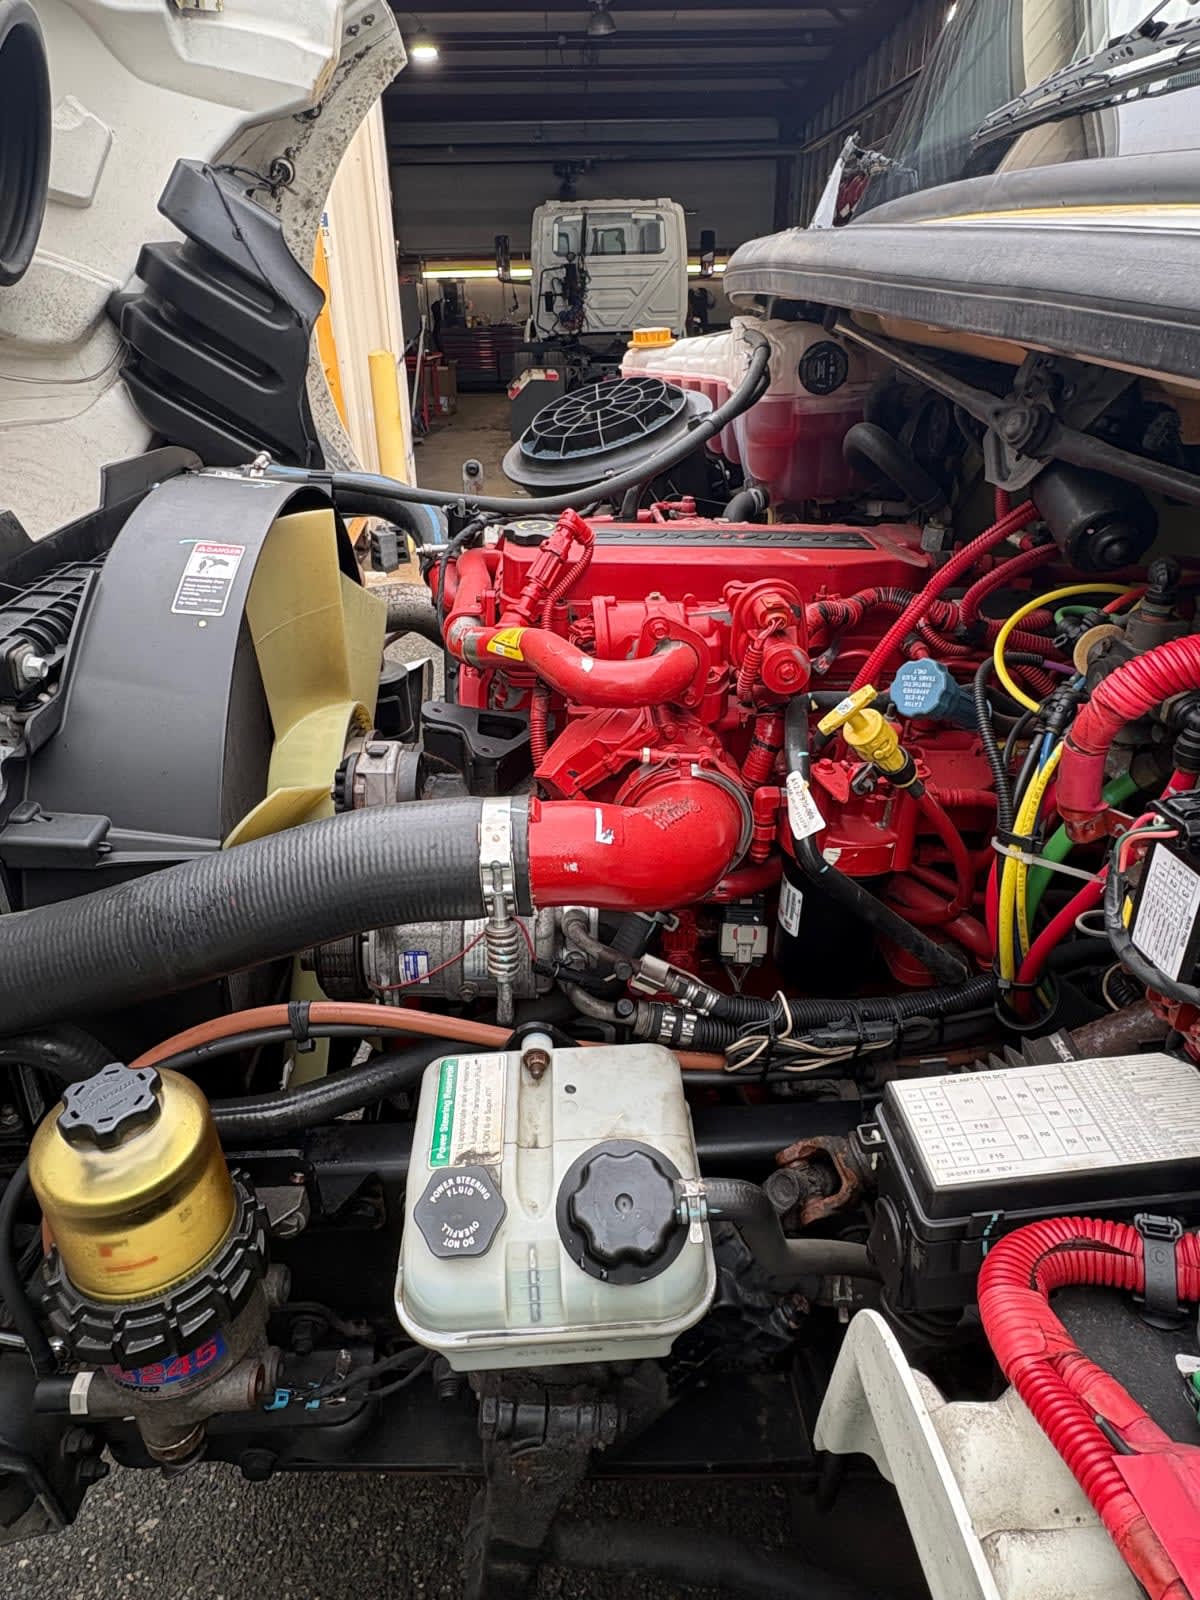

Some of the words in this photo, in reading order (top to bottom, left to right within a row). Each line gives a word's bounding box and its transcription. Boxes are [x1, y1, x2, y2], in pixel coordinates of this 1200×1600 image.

[207, 546, 241, 555] DANGER
[443, 1065, 456, 1099] Reservoir
[439, 1099, 454, 1133] Steering
[436, 1134, 449, 1160] Power
[429, 1178, 455, 1204] POWER
[456, 1176, 491, 1200] STEERING
[446, 1186, 474, 1197] FLUID
[441, 1221, 480, 1239] OVERFILL
[442, 1238, 460, 1248] NOT
[462, 1236, 475, 1247] DO
